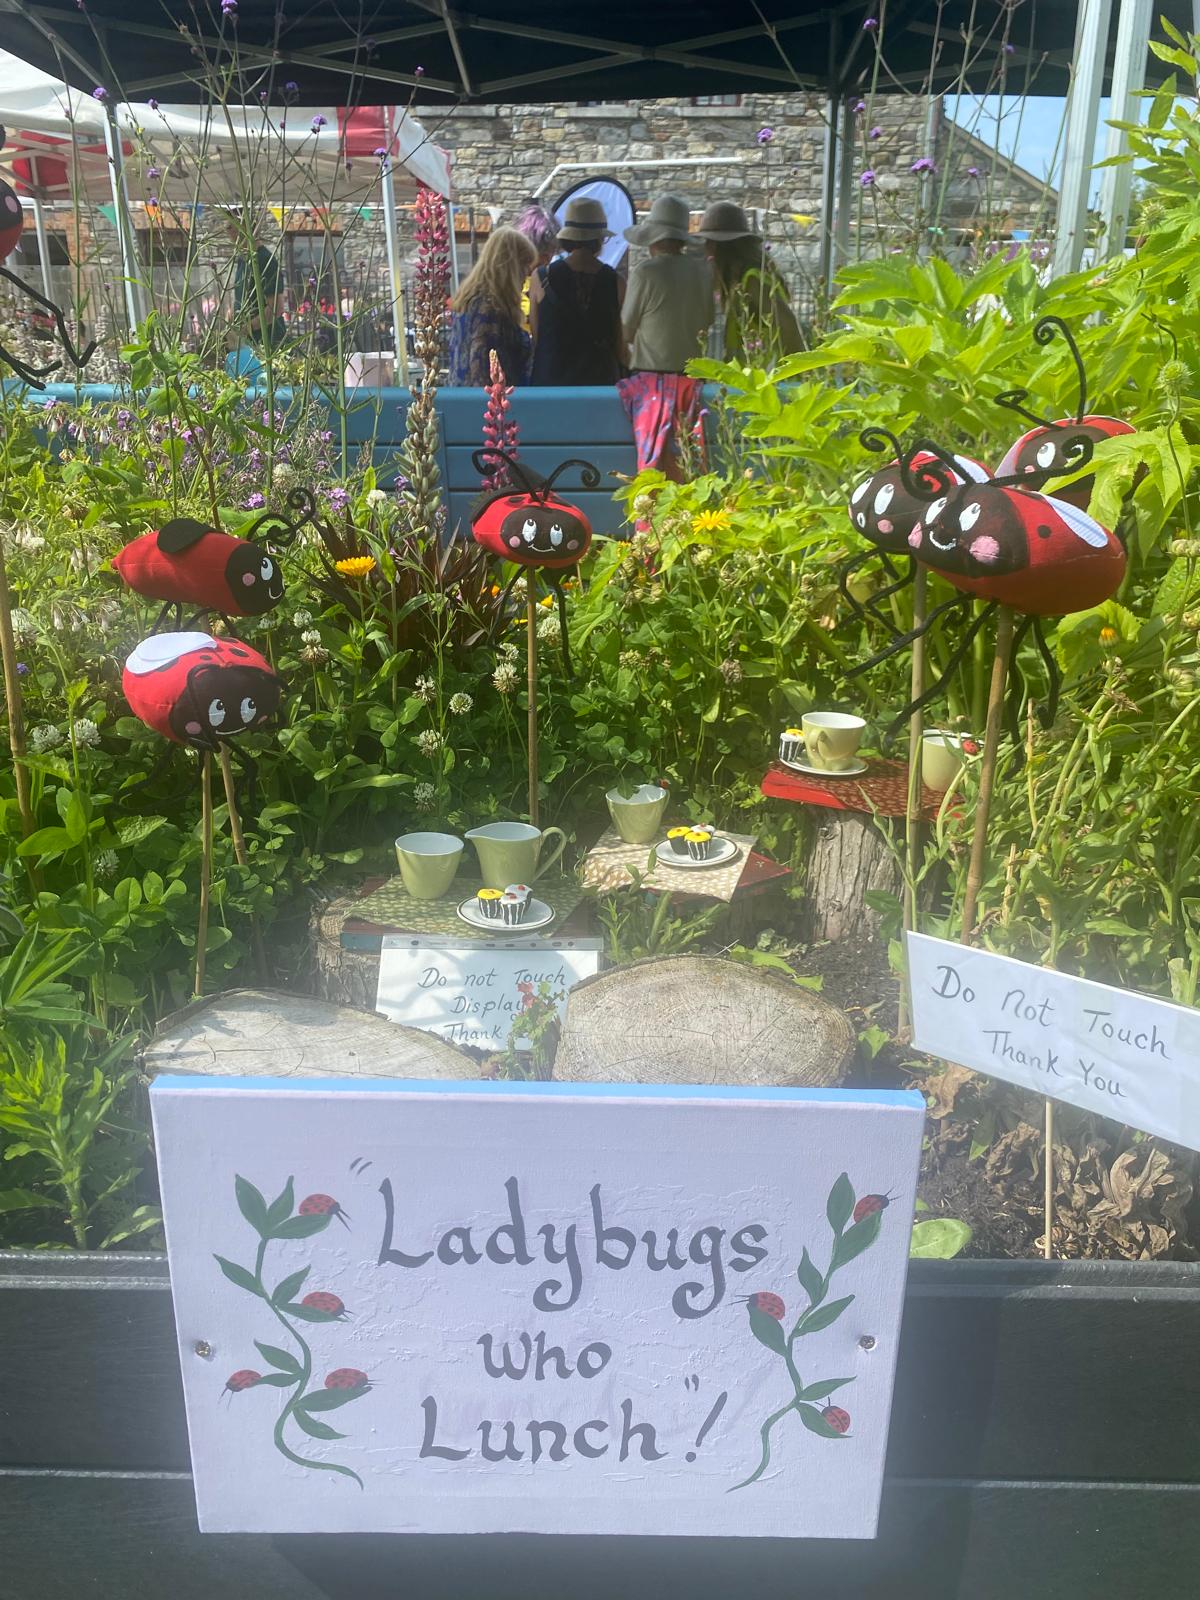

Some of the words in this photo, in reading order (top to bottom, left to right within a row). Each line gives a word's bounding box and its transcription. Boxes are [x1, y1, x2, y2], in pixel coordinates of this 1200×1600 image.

[417, 967, 448, 989] Do
[463, 967, 499, 987] not
[514, 965, 566, 986] Touch
[443, 1022, 503, 1041] Thank
[931, 965, 976, 1003] Do
[1082, 1008, 1172, 1061] Touch
[983, 1029, 1064, 1078] Thank
[1078, 1058, 1128, 1098] You
